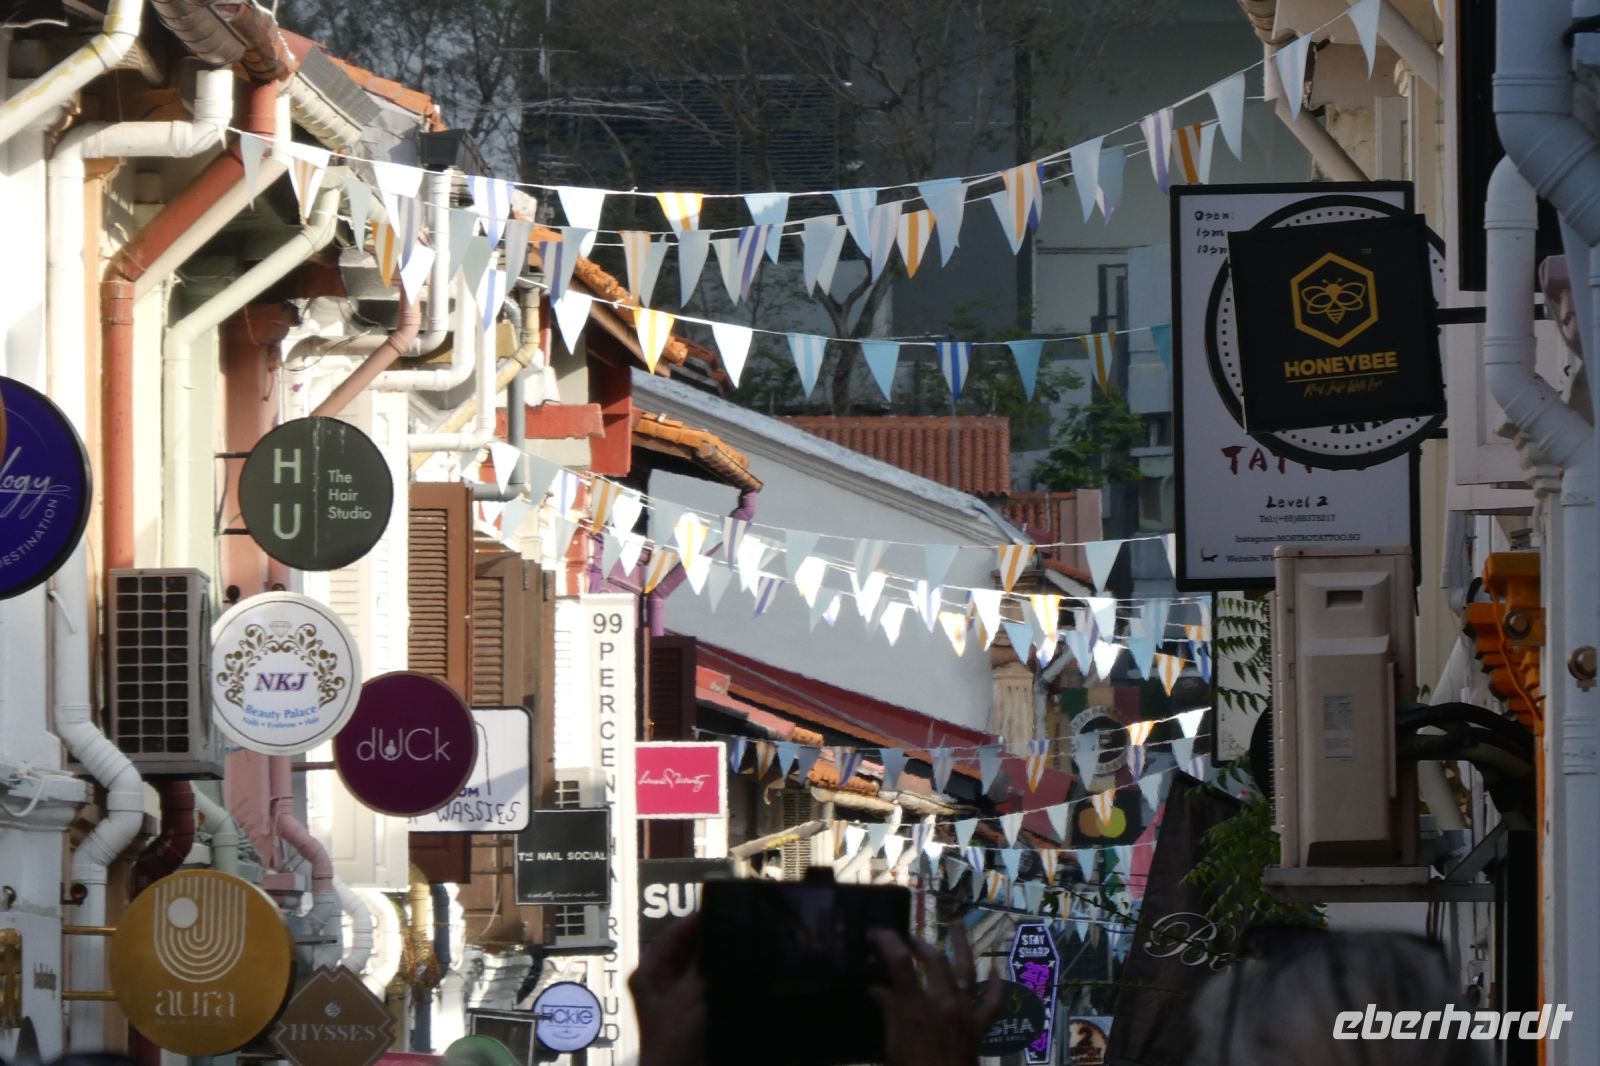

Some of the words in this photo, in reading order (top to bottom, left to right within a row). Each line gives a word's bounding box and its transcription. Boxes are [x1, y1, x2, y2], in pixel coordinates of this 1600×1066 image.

[1284, 351, 1398, 378] HONEYBEE
[328, 469, 353, 484] The
[328, 488, 359, 501] Hair
[1265, 496, 1310, 509] Level
[1316, 495, 1329, 508] 2
[328, 506, 373, 521] Studio
[592, 612, 622, 634] 99
[254, 672, 310, 692] NKJ
[245, 704, 280, 720] Beauty
[284, 706, 318, 719] Palace
[599, 641, 616, 805] PERCEN
[537, 851, 563, 861] NAIL
[567, 850, 608, 861] SOCIAL
[642, 882, 703, 919] SU
[1021, 934, 1046, 945] STAY
[1018, 946, 1050, 958] SHARP
[155, 990, 237, 1018] aura
[290, 1024, 376, 1041] HYSSES
